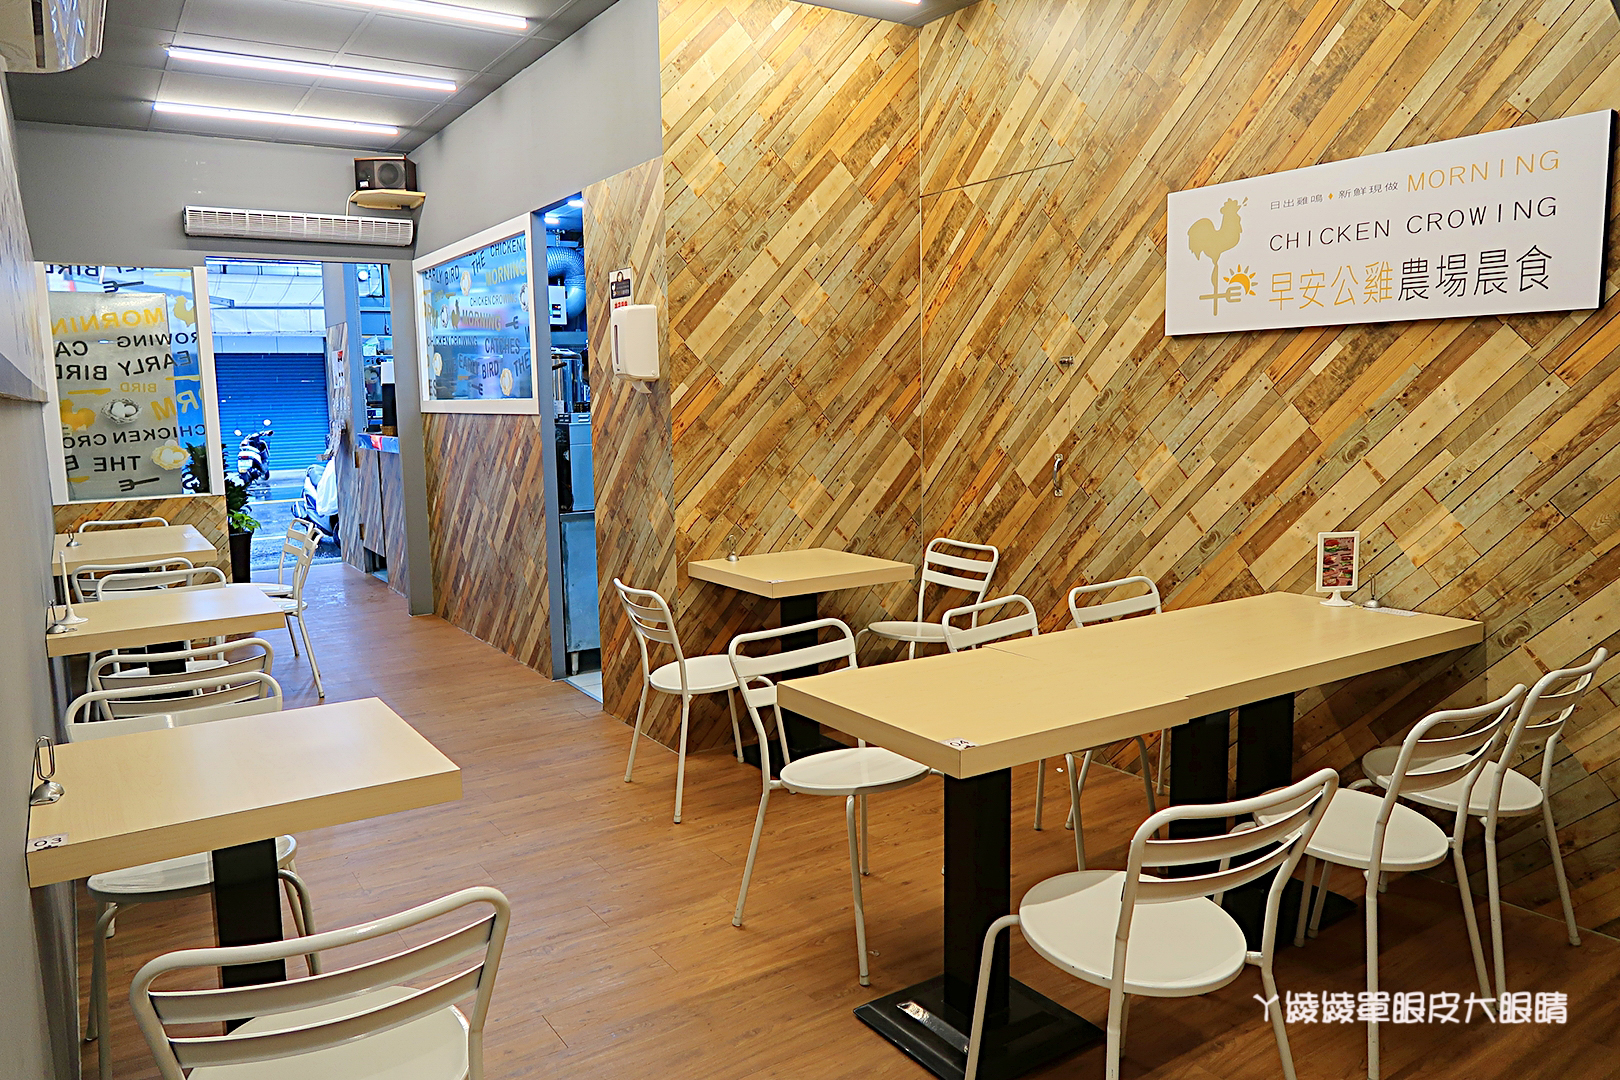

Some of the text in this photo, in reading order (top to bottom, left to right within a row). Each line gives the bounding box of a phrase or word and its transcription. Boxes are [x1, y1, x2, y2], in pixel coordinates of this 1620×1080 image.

[1406, 150, 1560, 193] MORNING
[1338, 181, 1399, 199] 新鮮現做
[1269, 196, 1558, 252] CHICKEN CROWING
[489, 238, 522, 257] CHICKEN
[444, 264, 460, 286] BIRD
[471, 250, 486, 276] THE
[486, 258, 527, 286] MORNING
[1268, 244, 1553, 311] 早安公雞農場晨食
[469, 295, 492, 307] CHICKEN
[461, 309, 503, 333] MORNING
[484, 337, 520, 355] CATCHES
[481, 360, 499, 380] BIRD
[513, 351, 530, 377] THE
